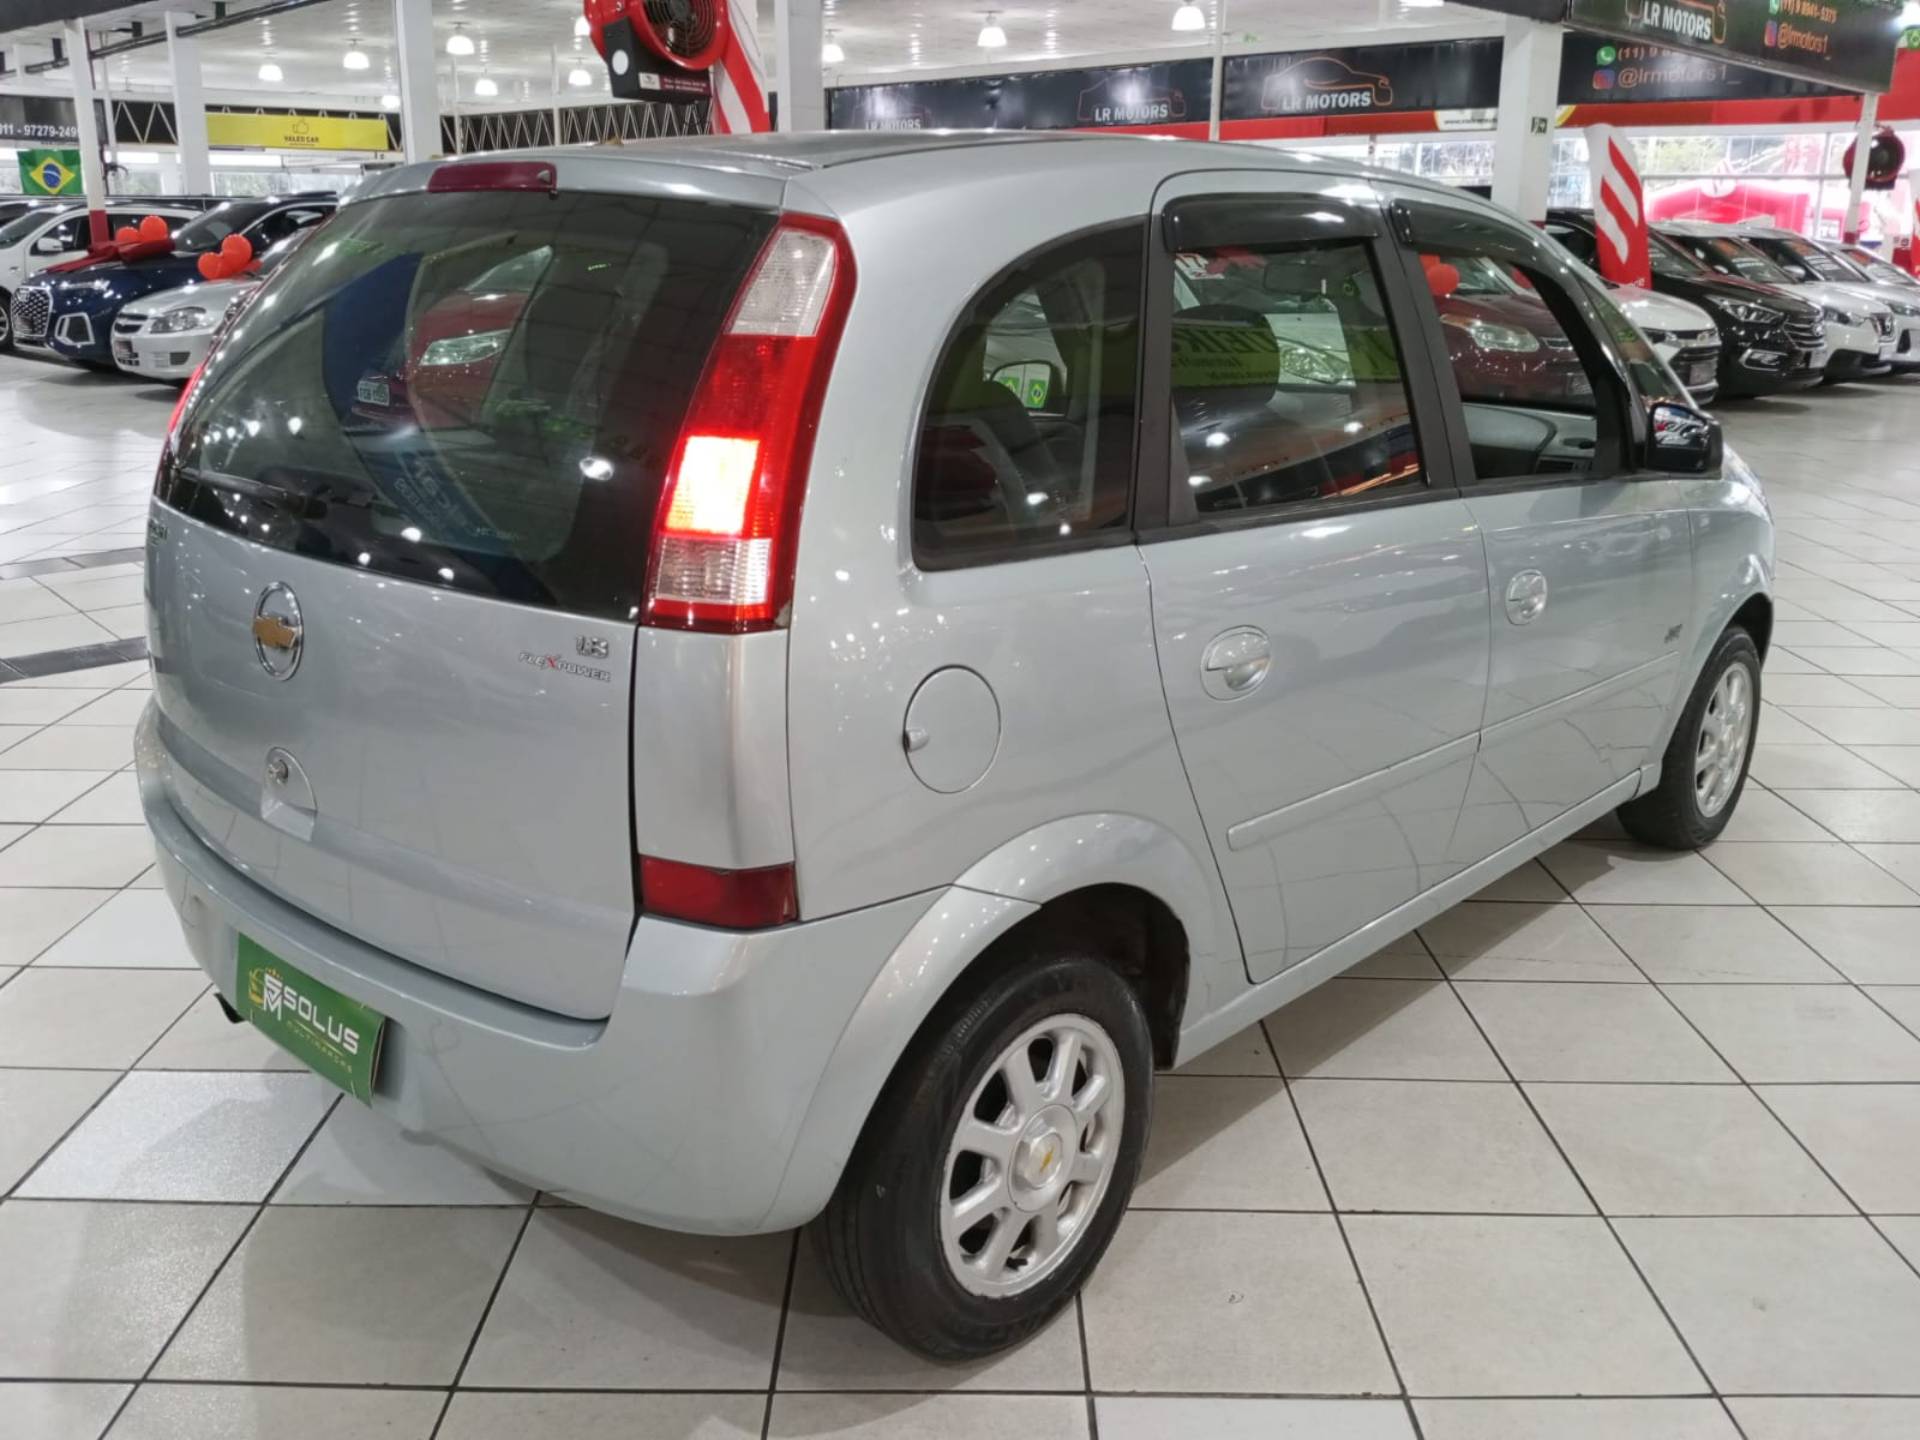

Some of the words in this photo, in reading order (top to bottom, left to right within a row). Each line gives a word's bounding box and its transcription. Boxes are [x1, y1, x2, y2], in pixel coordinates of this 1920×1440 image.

[1643, 0, 1660, 27] LR
[1662, 5, 1712, 40] MOTORS
[1282, 95, 1301, 111] LR
[1305, 91, 1371, 110] MOTORS
[1095, 107, 1111, 122] LR
[1114, 104, 1169, 121] MOTORS
[24, 124, 80, 138] 97279-249
[283, 985, 360, 1056] SOLUS
